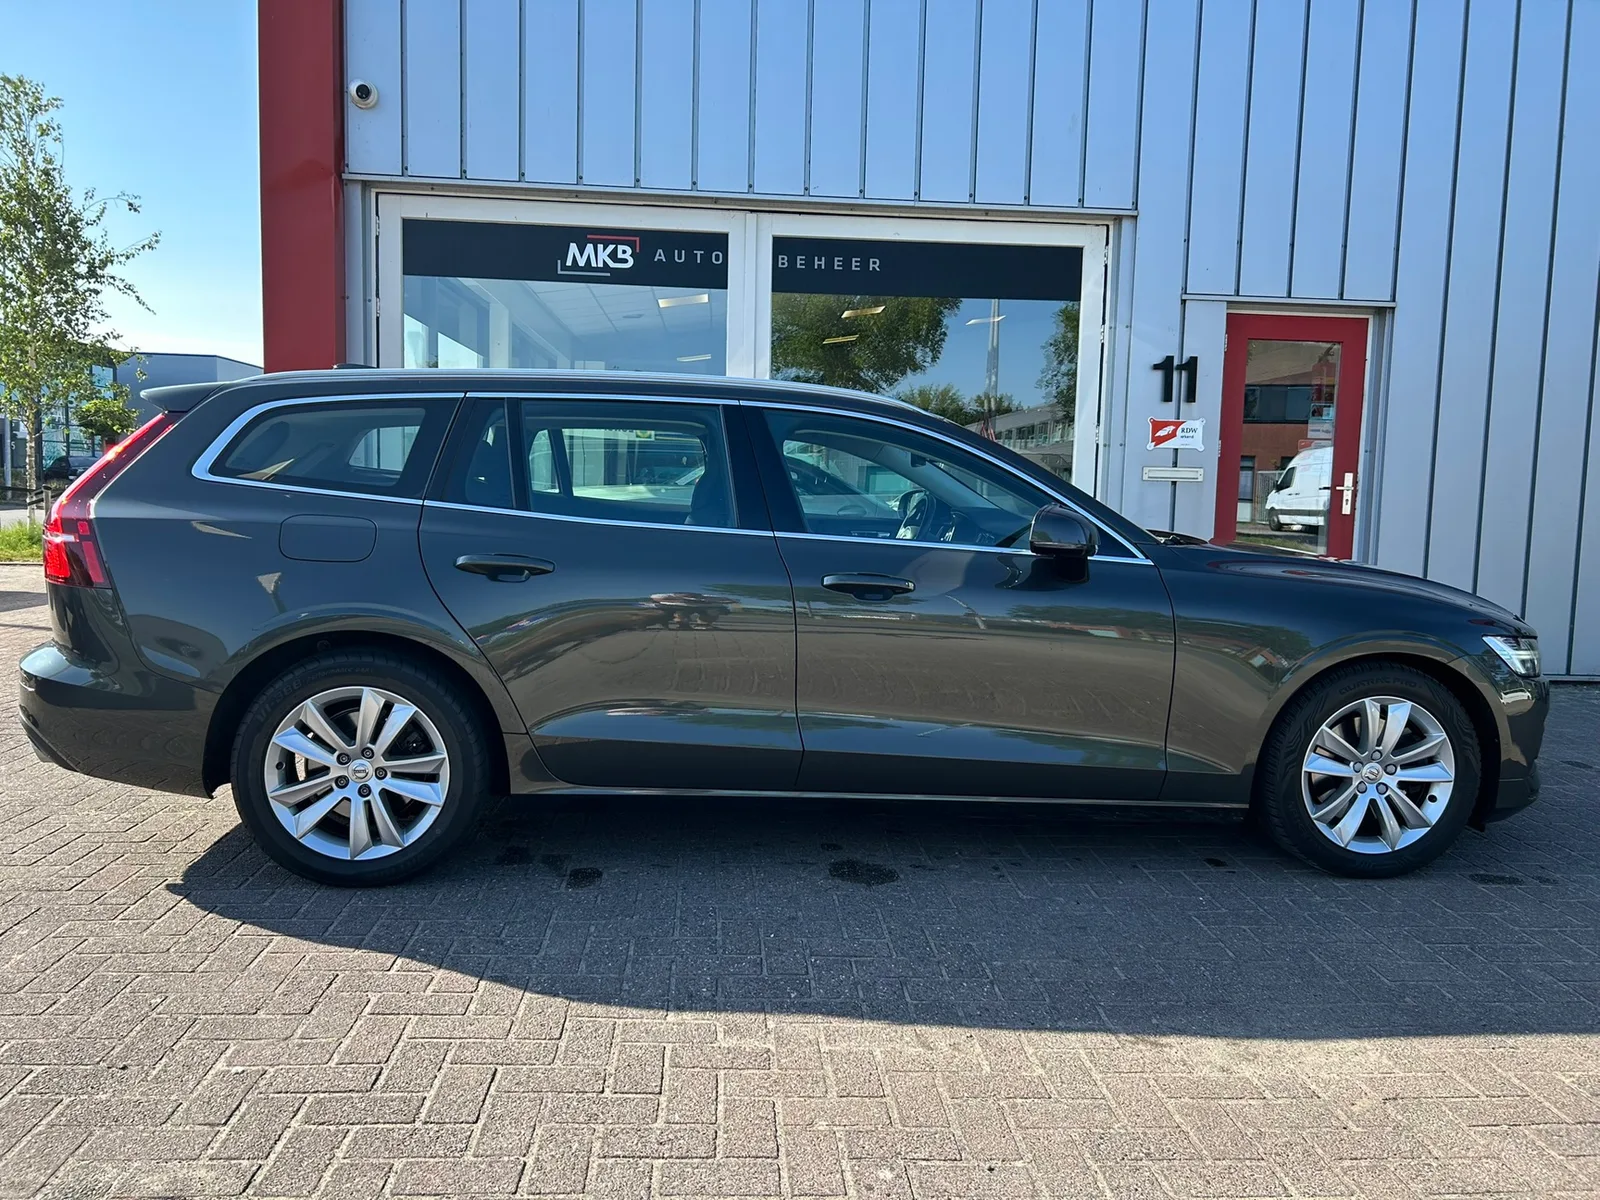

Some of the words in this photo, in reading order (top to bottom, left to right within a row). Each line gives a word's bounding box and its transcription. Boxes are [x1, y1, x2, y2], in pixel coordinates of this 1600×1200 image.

[565, 242, 634, 269] MKB
[654, 249, 723, 265] AUTO
[777, 254, 881, 272] BEHEER
[1152, 355, 1198, 403] 11
